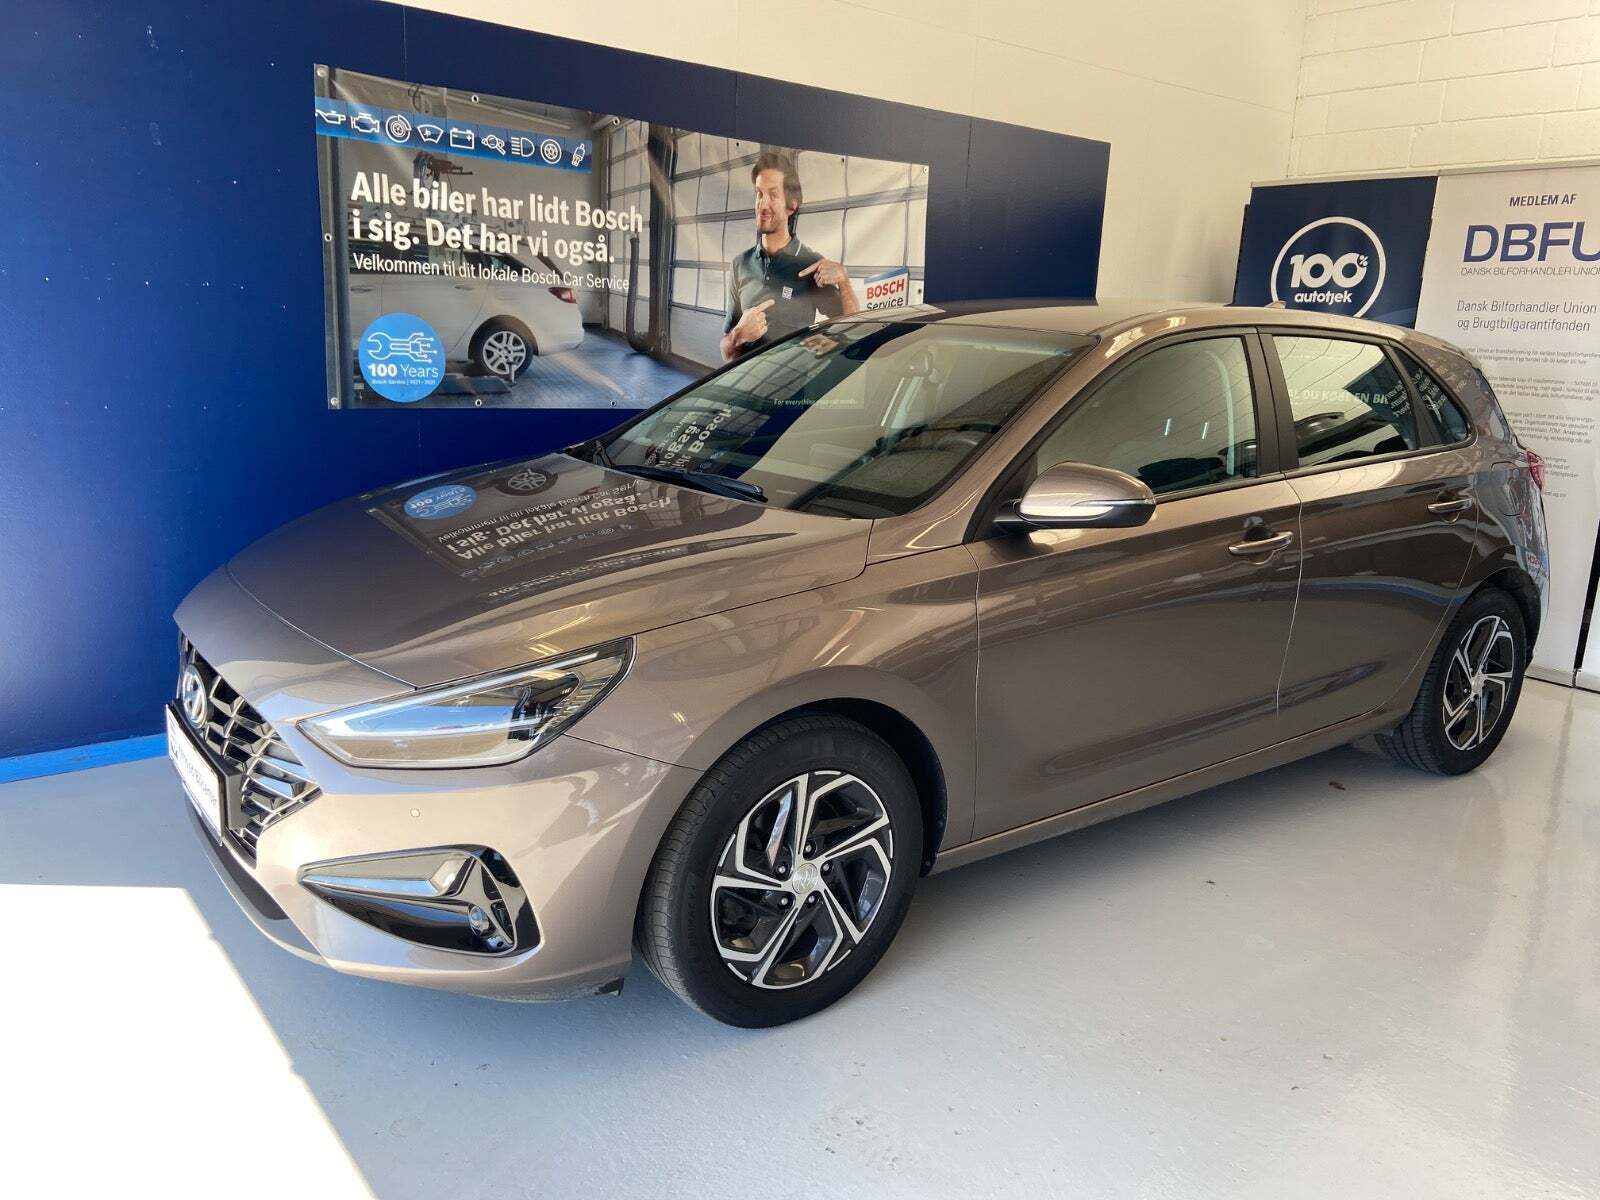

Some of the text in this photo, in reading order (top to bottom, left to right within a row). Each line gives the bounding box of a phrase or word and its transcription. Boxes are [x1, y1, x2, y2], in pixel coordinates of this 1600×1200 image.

[350, 171, 643, 233] Alle biler har lidt Bosch
[1509, 193, 1578, 208] MEDLEM AF
[352, 208, 615, 267] i sig. Det har vi også.
[1463, 221, 1600, 263] DBFU
[352, 252, 630, 290] Velkommen til dit lokale Bosch Car Service
[1460, 266, 1492, 277] DANSK
[1492, 266, 1572, 277] BILFORHANDLER
[866, 278, 905, 300] BOSCH
[866, 297, 904, 311] Service
[1294, 290, 1353, 305] autotjek
[1457, 300, 1598, 315] Dansk Bilforhandler Union
[1457, 317, 1591, 333] og Brugtbilgarantifonden
[367, 363, 439, 378] 100 Years
